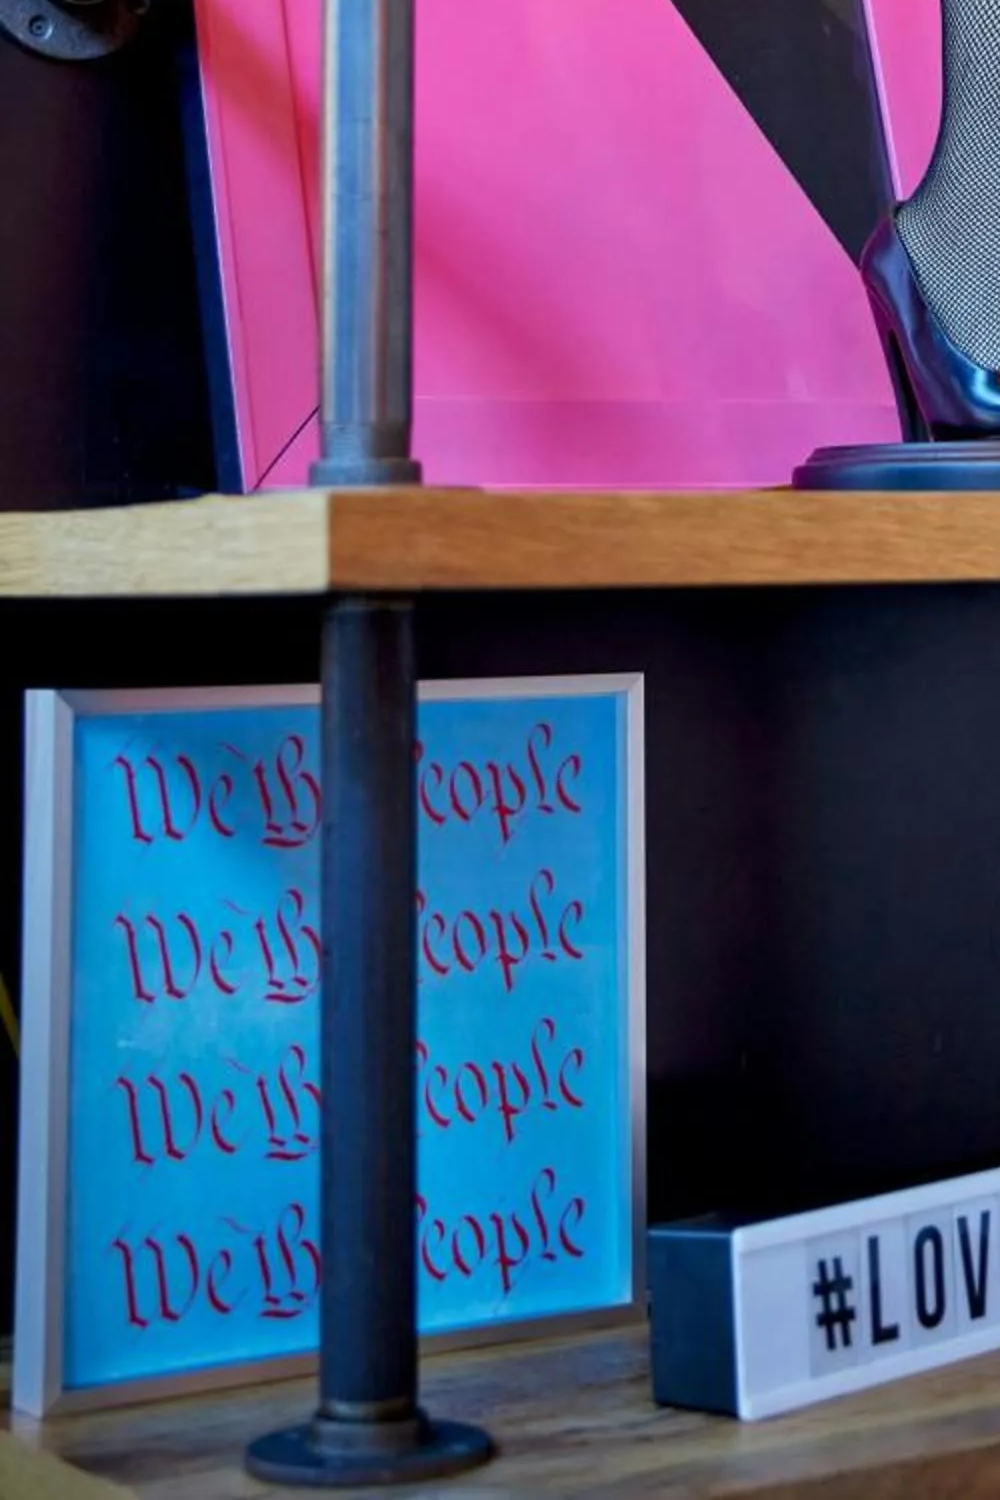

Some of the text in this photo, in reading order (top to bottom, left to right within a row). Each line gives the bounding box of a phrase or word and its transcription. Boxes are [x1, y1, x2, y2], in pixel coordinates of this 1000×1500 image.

[113, 752, 236, 845] We
[412, 722, 582, 845] eople
[113, 910, 237, 1004] We
[415, 868, 584, 994] eople
[115, 1071, 237, 1166] We
[414, 1016, 584, 1145] eople
[111, 1231, 233, 1330] We
[414, 1167, 586, 1296] eople
